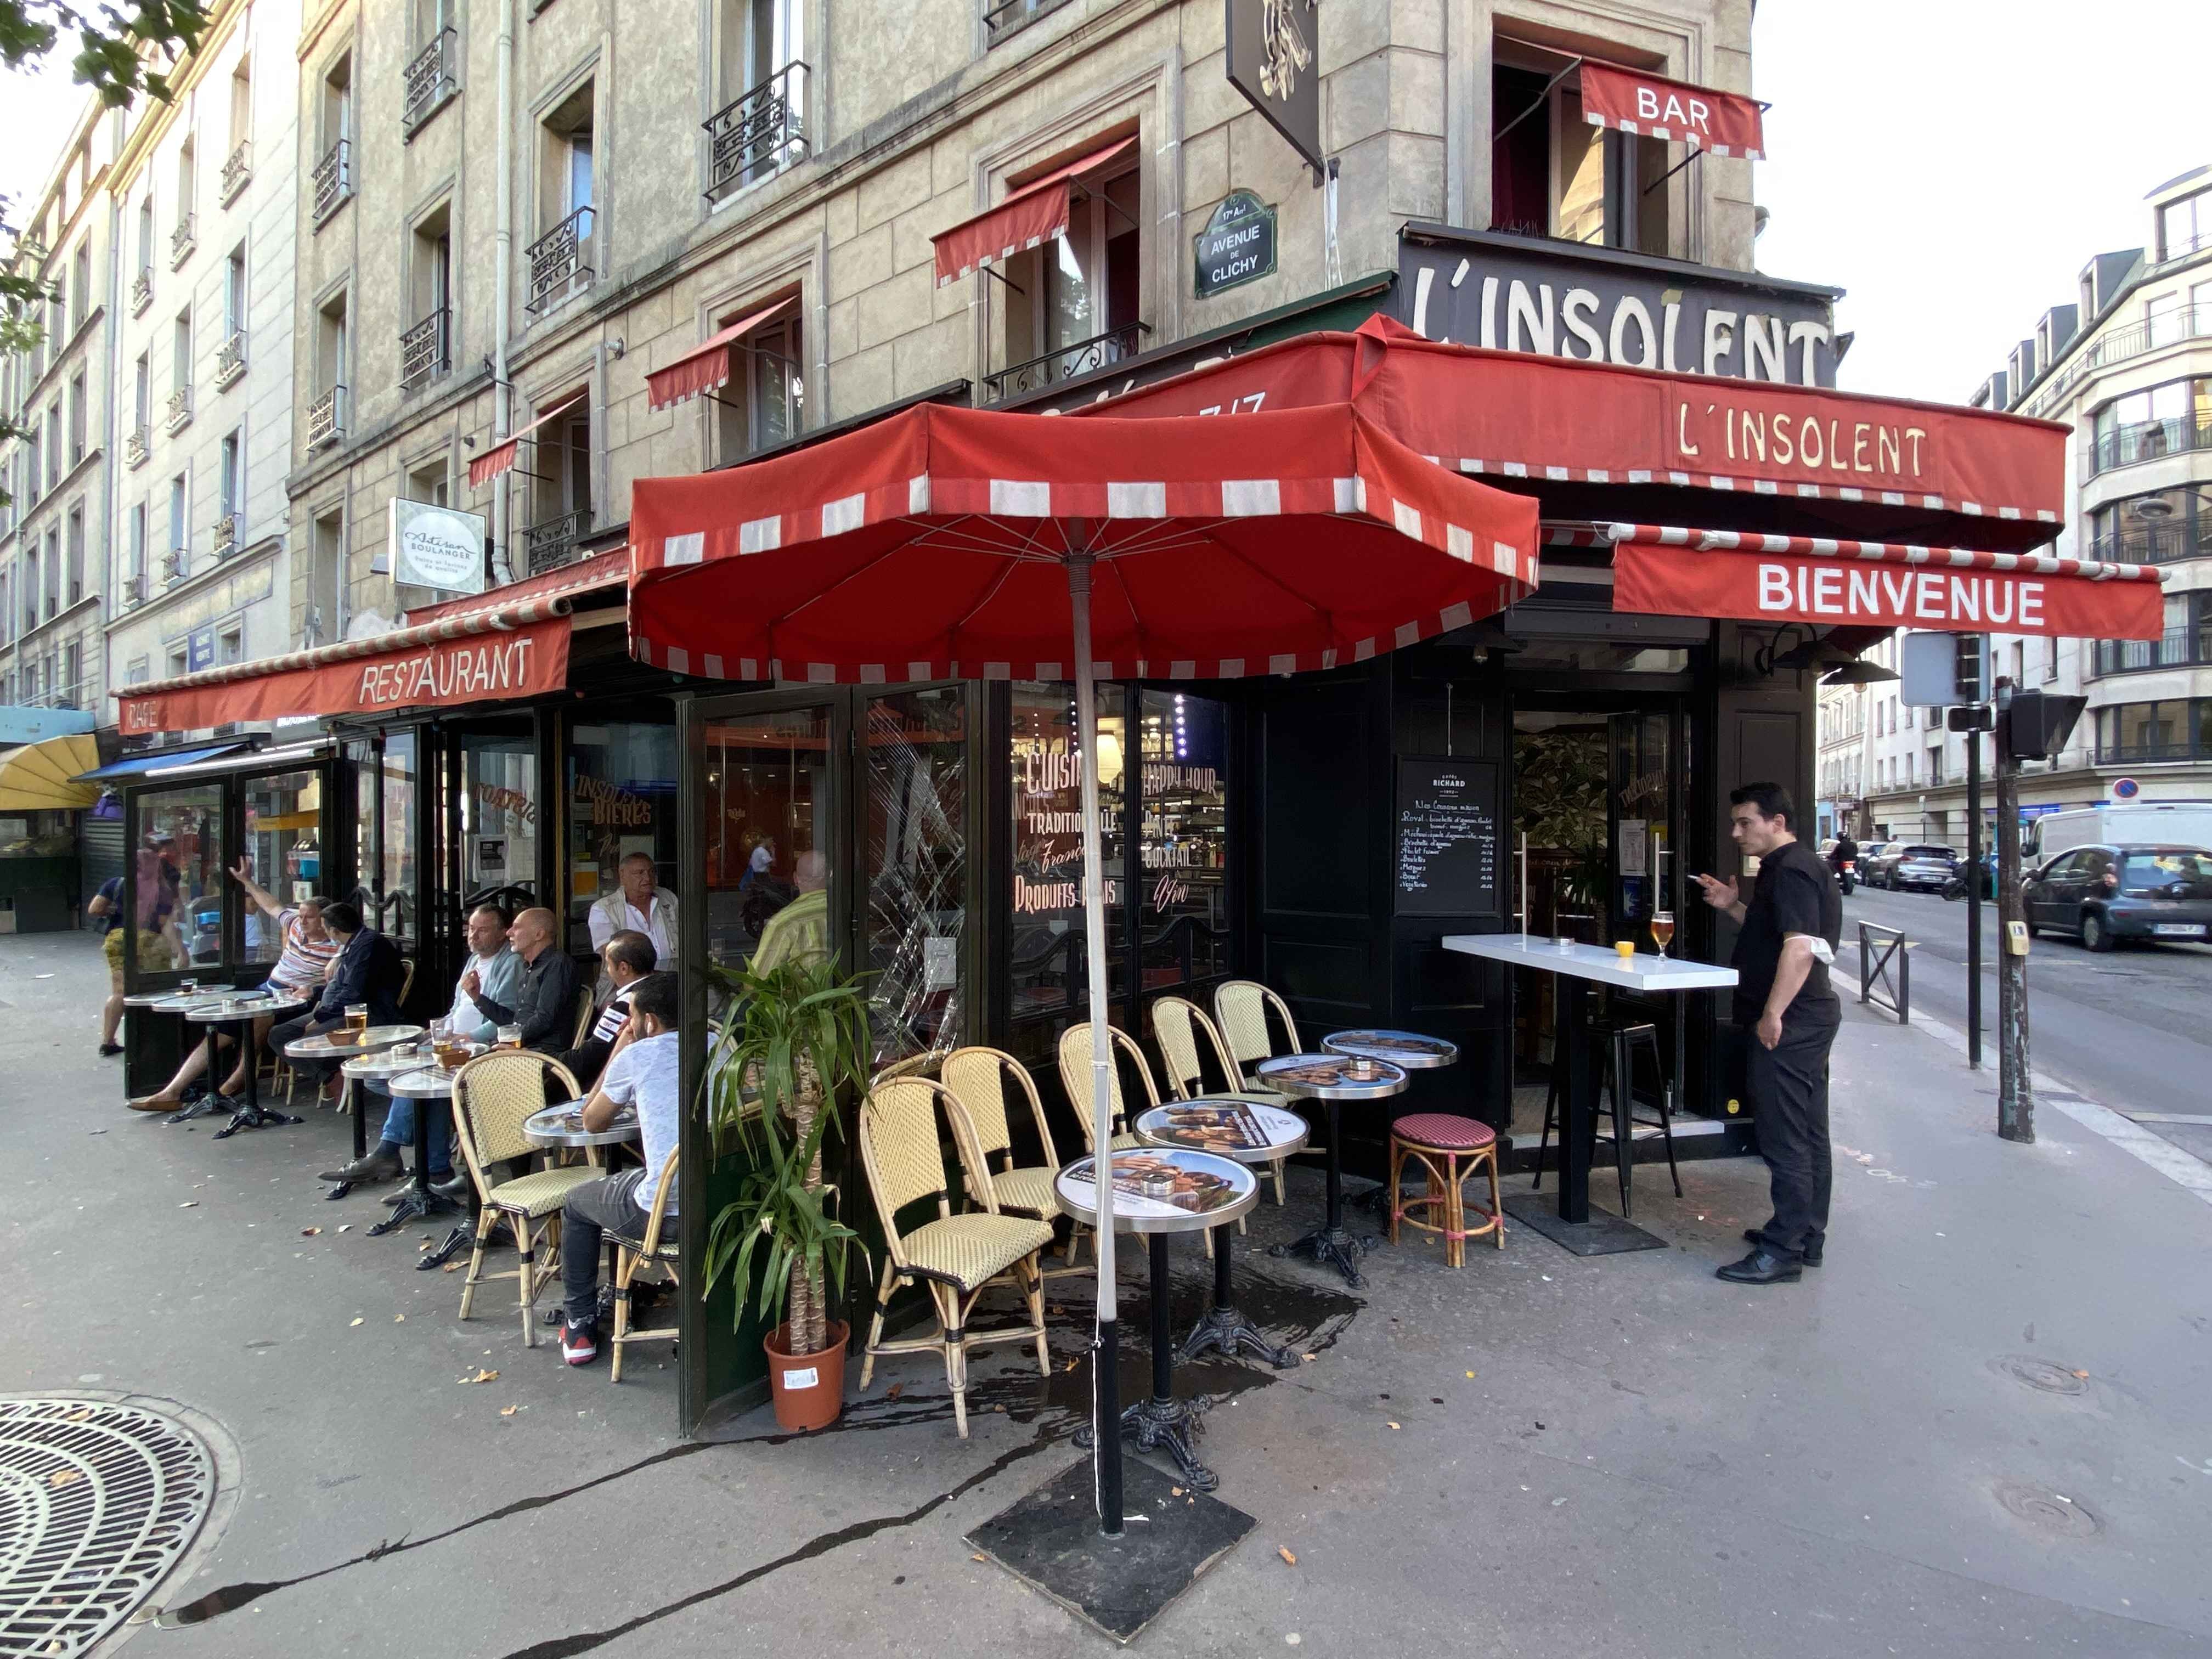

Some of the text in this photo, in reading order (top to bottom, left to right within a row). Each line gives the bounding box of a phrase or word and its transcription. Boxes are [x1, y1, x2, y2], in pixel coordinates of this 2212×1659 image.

[1638, 87, 1709, 135] BAR
[1211, 225, 1260, 255] AVENUE
[1230, 250, 1239, 259] DE
[1212, 255, 1258, 282] CLICHY
[405, 532, 477, 554] Artisan
[411, 543, 470, 560] BOULANGER
[1759, 563, 2044, 625] BIENVENUE
[359, 638, 532, 704] RESTAURANT
[1143, 763, 1220, 799] HAPPY HOUR
[1144, 841, 1193, 869] COCKTAIL
